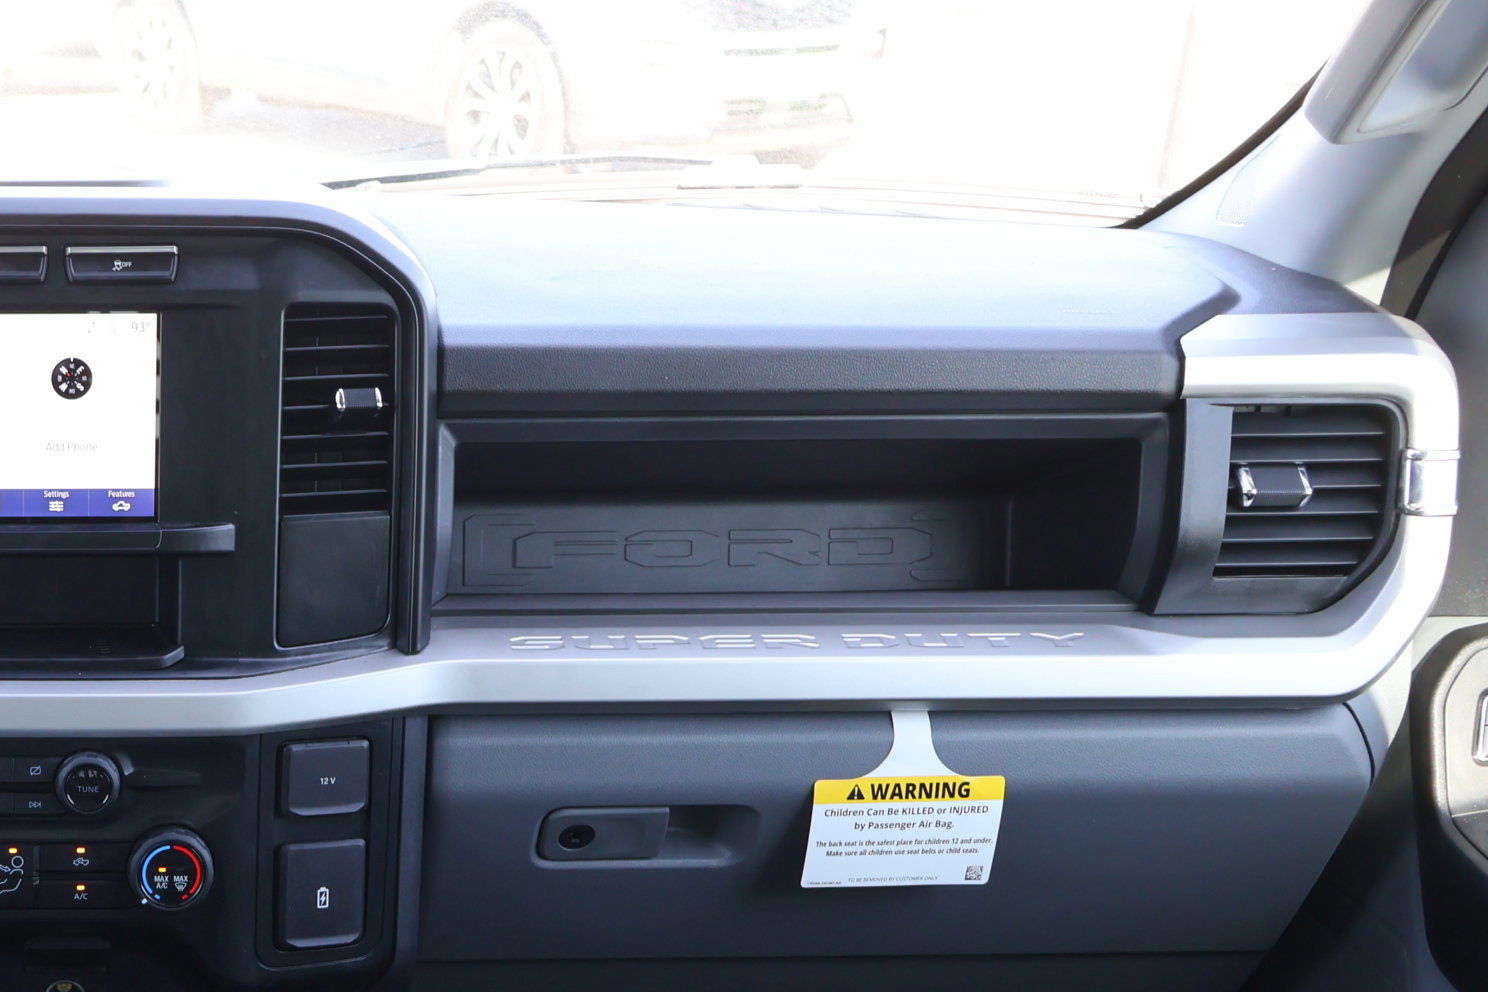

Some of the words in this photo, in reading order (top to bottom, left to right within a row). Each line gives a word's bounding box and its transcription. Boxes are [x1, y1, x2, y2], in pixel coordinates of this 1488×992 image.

[46, 442, 64, 452] Add
[67, 441, 98, 452] Phone
[43, 490, 69, 500] Settings
[108, 490, 135, 498] Features
[512, 527, 933, 568] FORD
[510, 634, 820, 650] SUPER
[841, 632, 1084, 648] DUTY
[320, 777, 329, 785] 12
[77, 785, 99, 793] TUNE
[870, 781, 971, 800] WARNING
[824, 808, 865, 817] Children
[867, 808, 884, 816] Can
[887, 808, 899, 816] Be
[901, 807, 934, 815] KILLED
[949, 805, 989, 814] INJURED
[854, 821, 865, 831] by
[867, 821, 916, 830] Passenger
[918, 820, 933, 828] Air
[935, 820, 955, 830] Bag.
[896, 839, 912, 847] place
[73, 892, 88, 900] A/C
